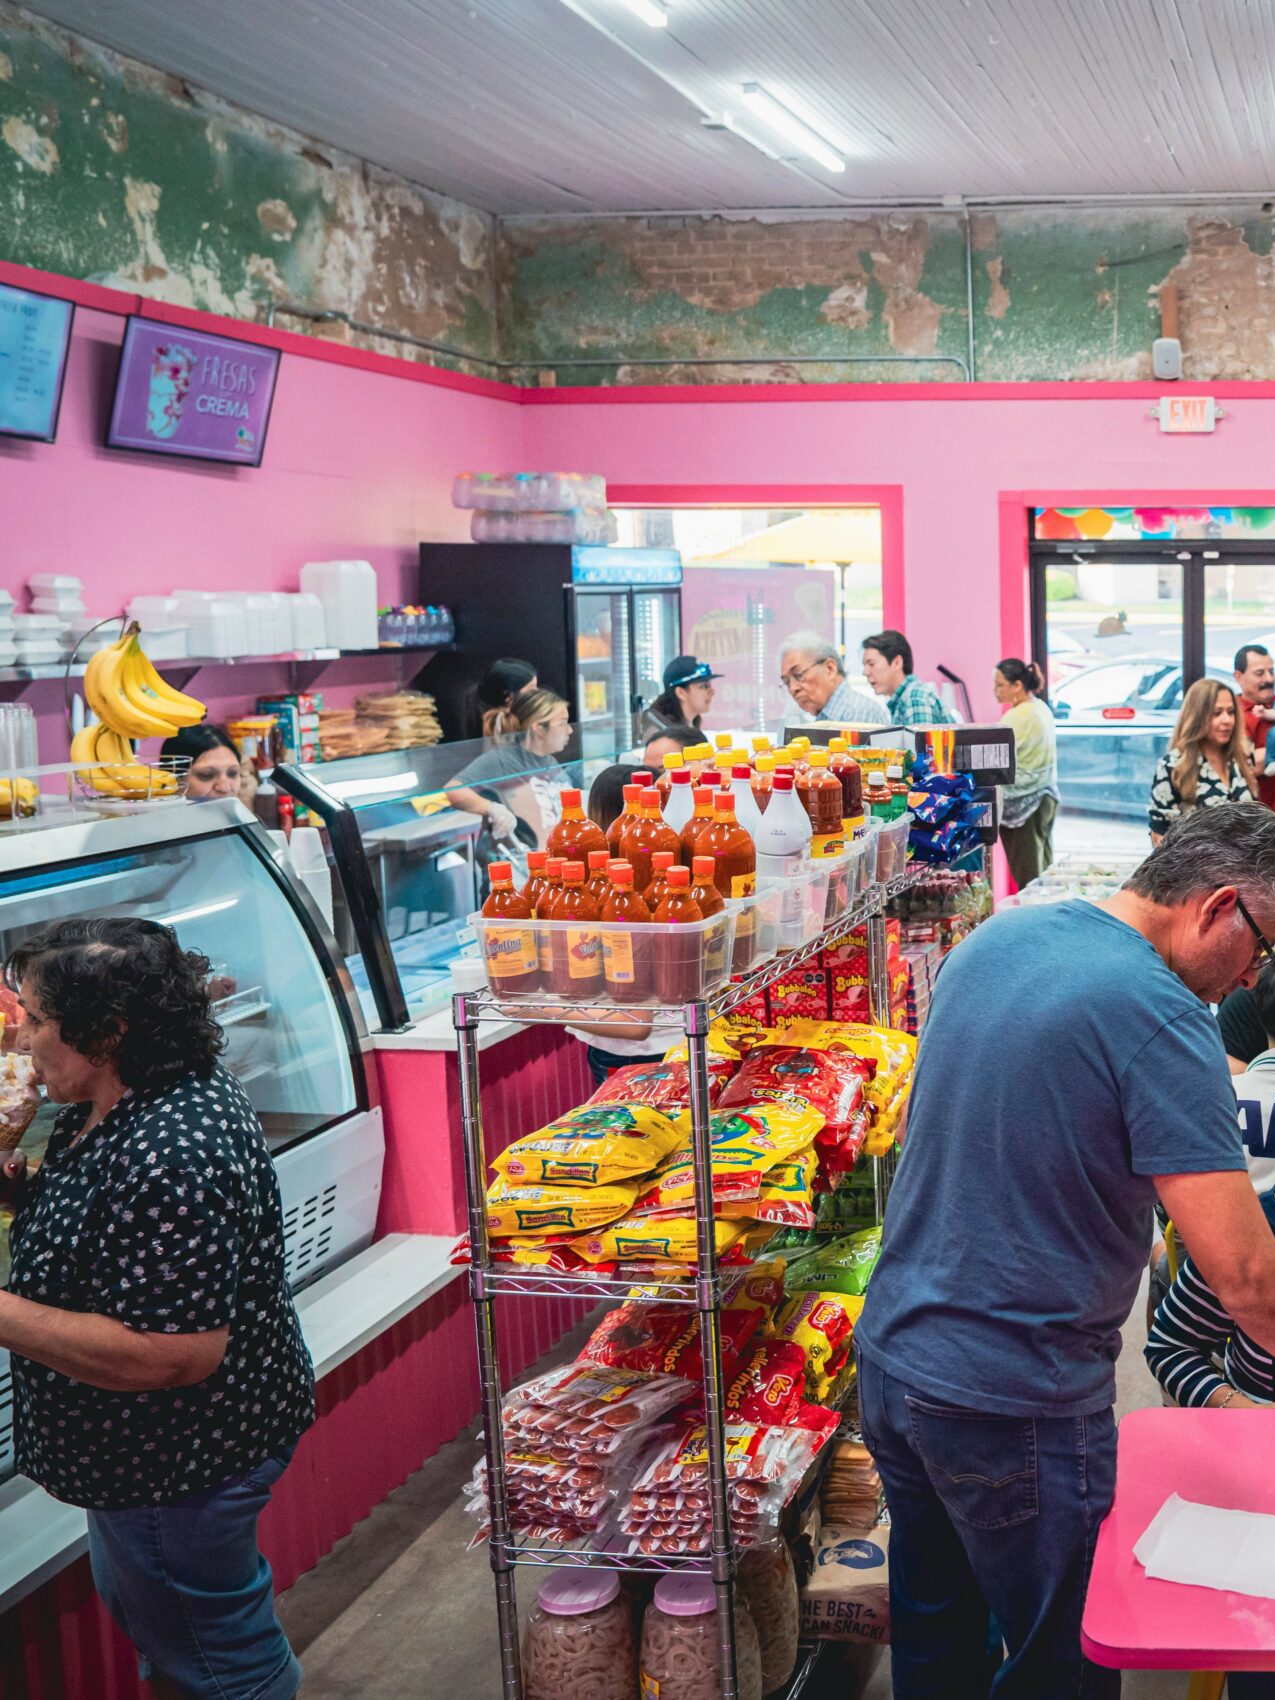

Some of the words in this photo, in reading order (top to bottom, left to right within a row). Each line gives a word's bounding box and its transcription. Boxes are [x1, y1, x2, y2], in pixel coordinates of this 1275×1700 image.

[201, 356, 258, 396] FRESAS
[196, 394, 250, 420] CREMA
[1170, 399, 1207, 430] EXIT
[776, 984, 817, 998] Bubbaloo
[768, 1375, 791, 1403] Vero
[802, 1600, 822, 1618] HE
[827, 1601, 864, 1619] BEST
[833, 1620, 884, 1639] SNACK!
